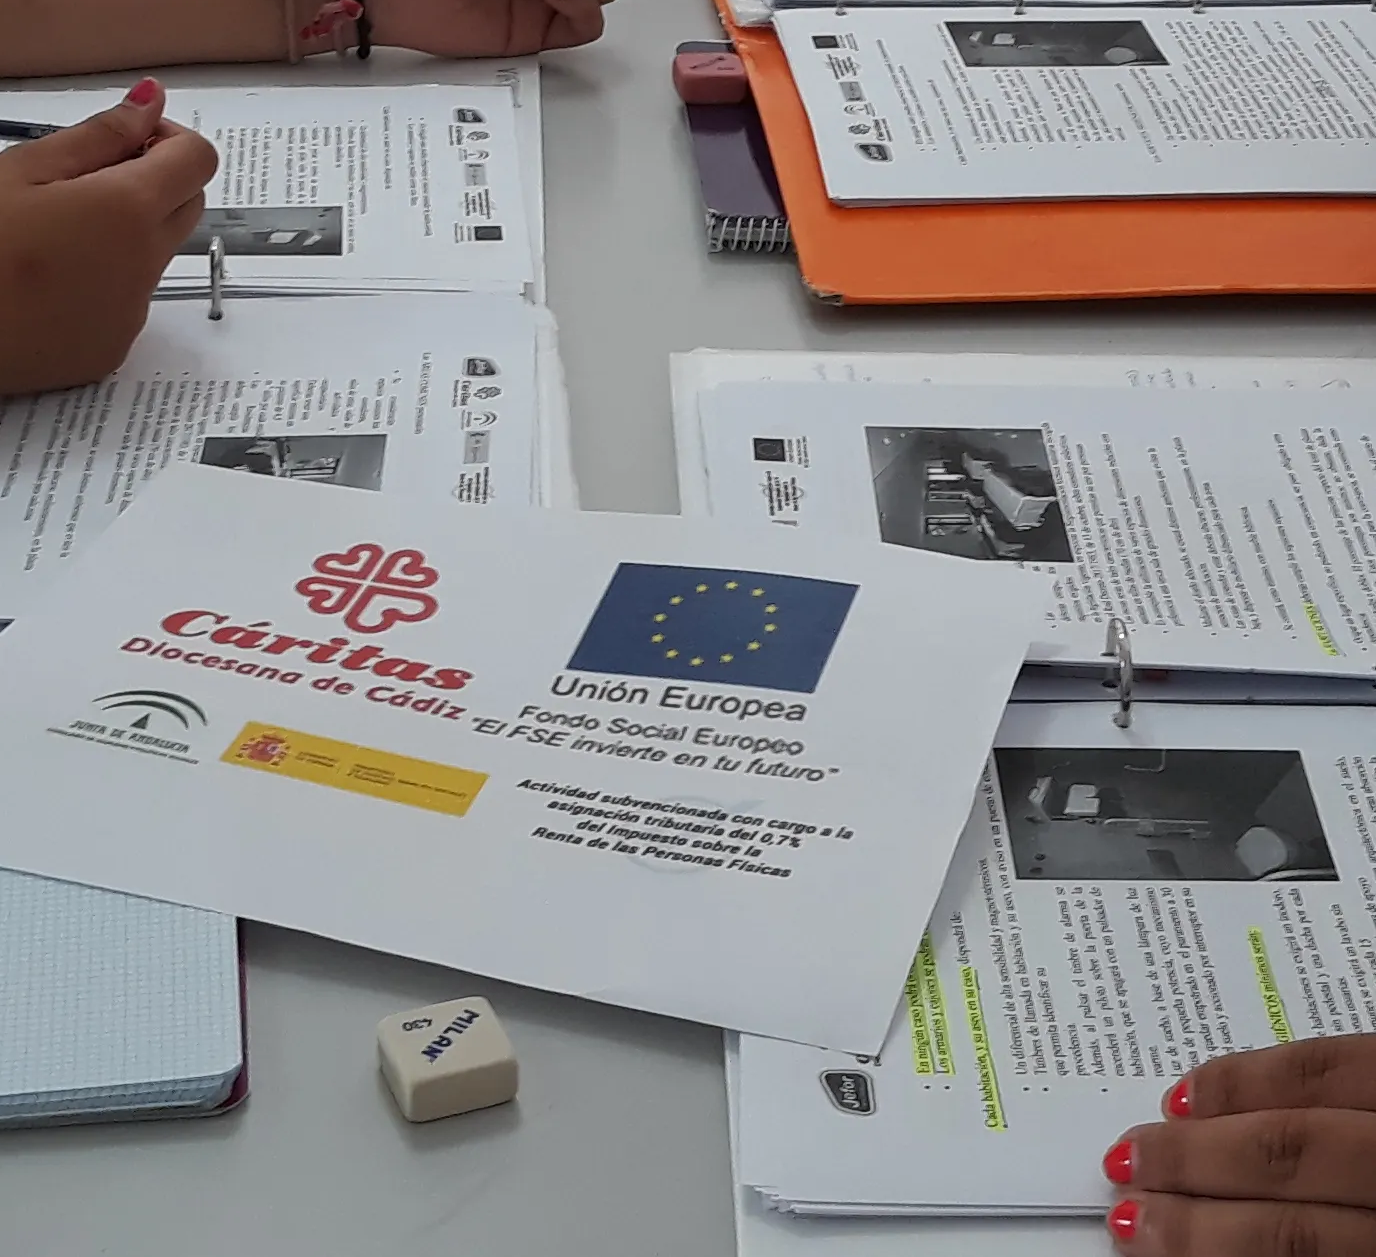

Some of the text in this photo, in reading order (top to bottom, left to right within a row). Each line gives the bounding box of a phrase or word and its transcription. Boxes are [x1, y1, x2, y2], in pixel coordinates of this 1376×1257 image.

[161, 609, 475, 691] Cáritas
[120, 636, 466, 720] Diocesana de Cádiz
[550, 674, 808, 722] Unión Europea
[506, 725, 569, 748] FSE
[570, 734, 668, 763] invierte
[672, 751, 709, 768] en
[712, 755, 742, 774] tu
[517, 705, 806, 757] Fondo Social Europeo
[516, 777, 856, 841] Actividad subvencionada con cargo a la
[546, 799, 641, 824] asignación
[643, 813, 725, 839] tributaria
[728, 825, 758, 842] del
[529, 826, 793, 880] Renta de las Personas Físicas
[575, 818, 763, 857] del Impuesto sobre la
[1062, 932, 1076, 943] de
[1001, 1000, 1016, 1012] de
[1263, 993, 1288, 1043] GIÉNICOS
[420, 1009, 481, 1064] MILAN
[1025, 1024, 1040, 1037] de
[839, 1075, 862, 1109] Jefor
[982, 1103, 999, 1128] Cada
